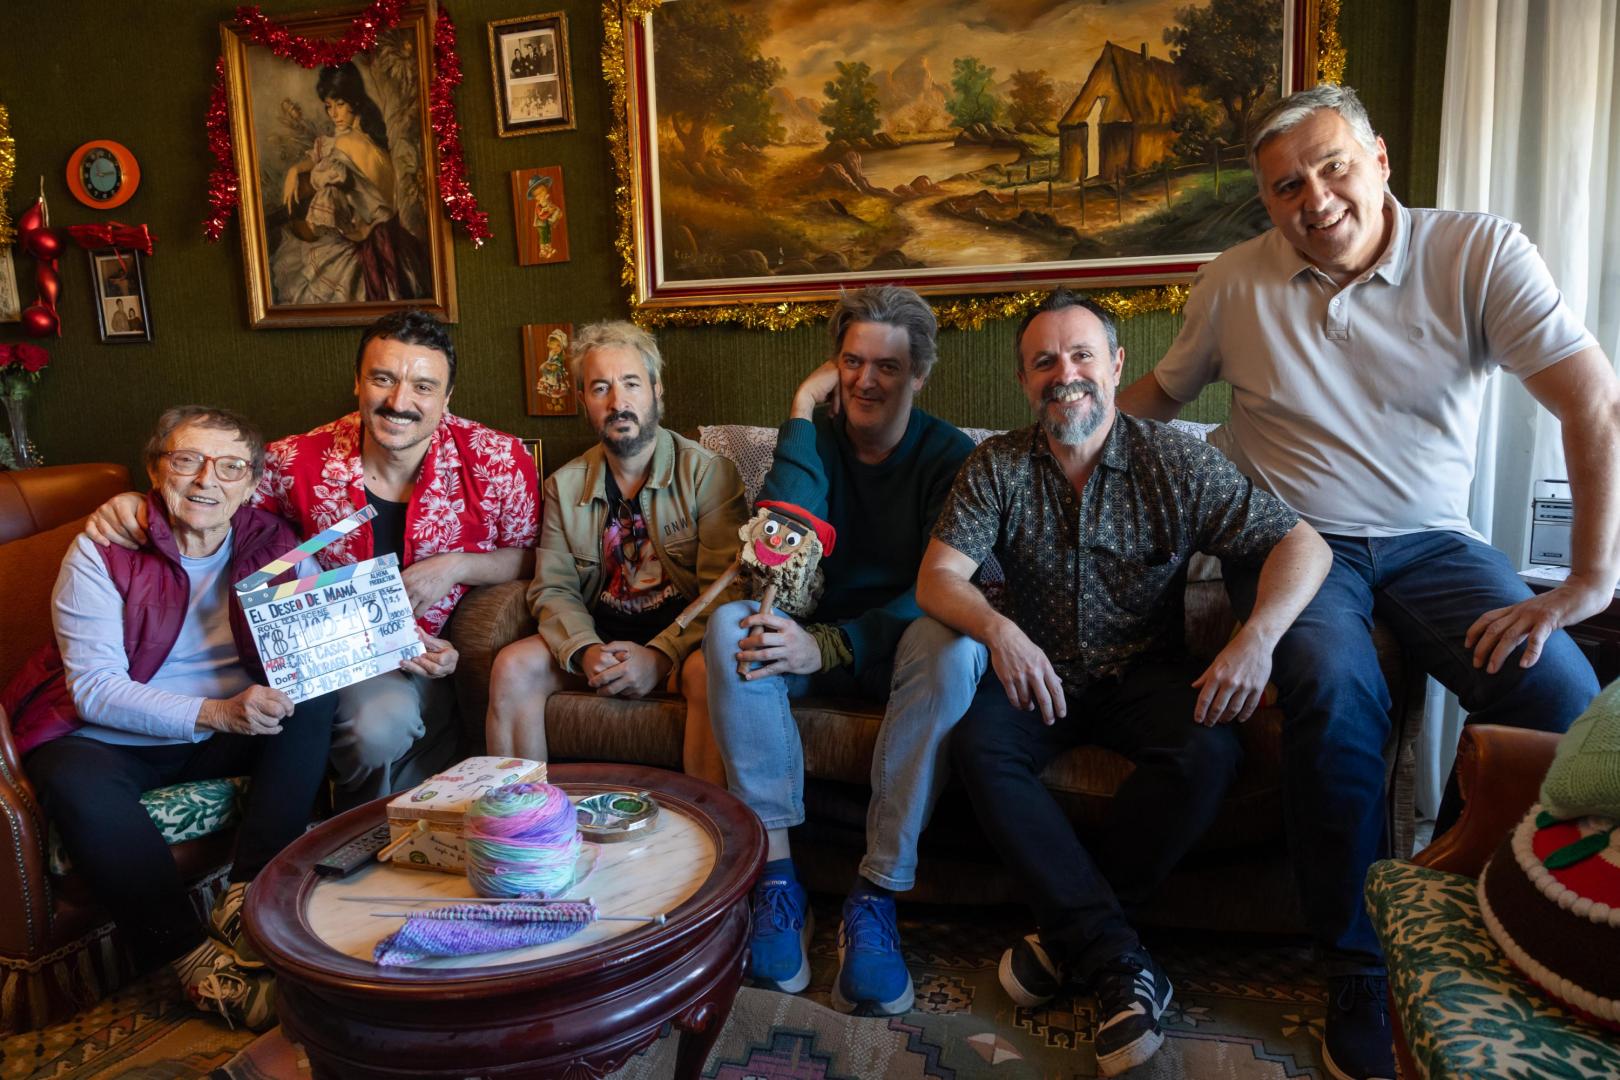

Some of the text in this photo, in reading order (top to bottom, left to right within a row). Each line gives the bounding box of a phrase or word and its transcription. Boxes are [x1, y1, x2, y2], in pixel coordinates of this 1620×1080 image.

[249, 609, 266, 624] EL
[268, 599, 303, 618] DESEO
[305, 593, 321, 608] DE
[323, 581, 358, 602] MAMÁ
[358, 592, 377, 602] TAKE
[301, 608, 328, 621] SCENE
[257, 623, 280, 633] ROLL
